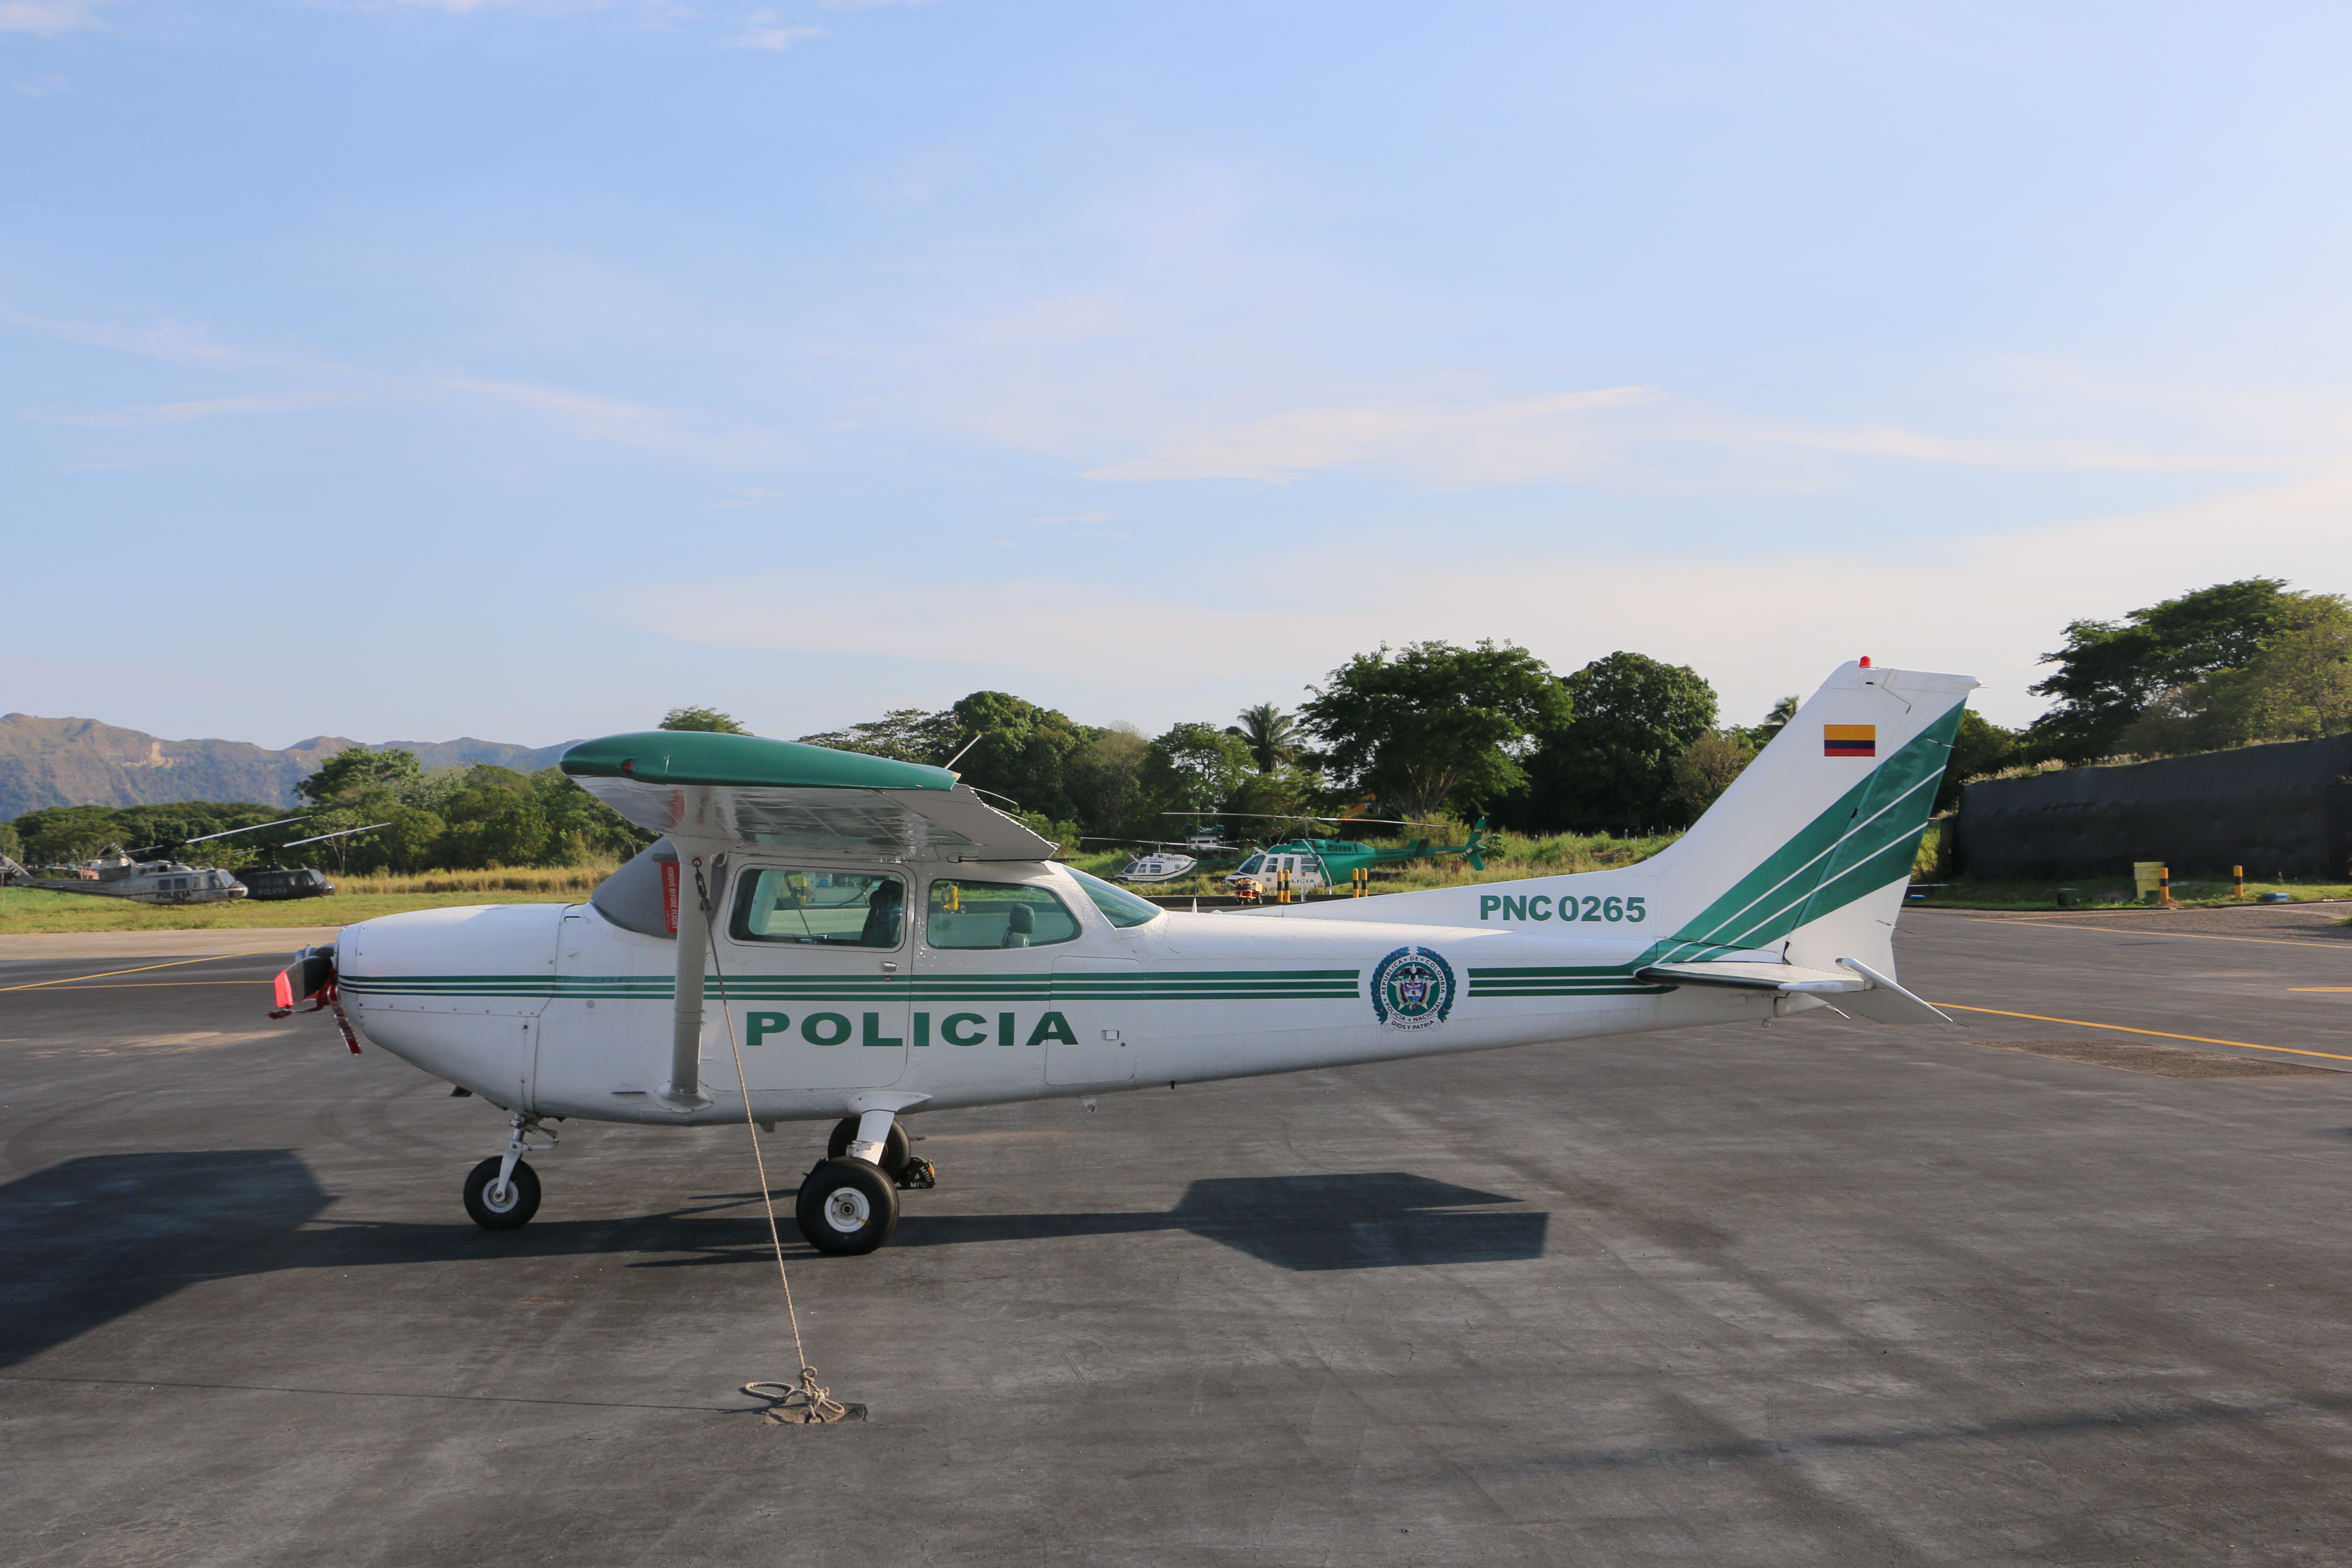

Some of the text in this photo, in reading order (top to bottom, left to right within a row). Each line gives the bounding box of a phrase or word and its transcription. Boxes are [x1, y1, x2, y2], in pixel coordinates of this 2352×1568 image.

[667, 867, 676, 887] REMOVE
[156, 890, 191, 900] POLICIA
[258, 887, 288, 895] POLICIA
[669, 888, 677, 908] BEFORE
[1426, 960, 1445, 993] COLOMBIA
[1413, 1001, 1442, 1022] NACIONAL
[746, 1011, 1079, 1047] POLICIA
[1413, 1020, 1434, 1030] PATRIA
